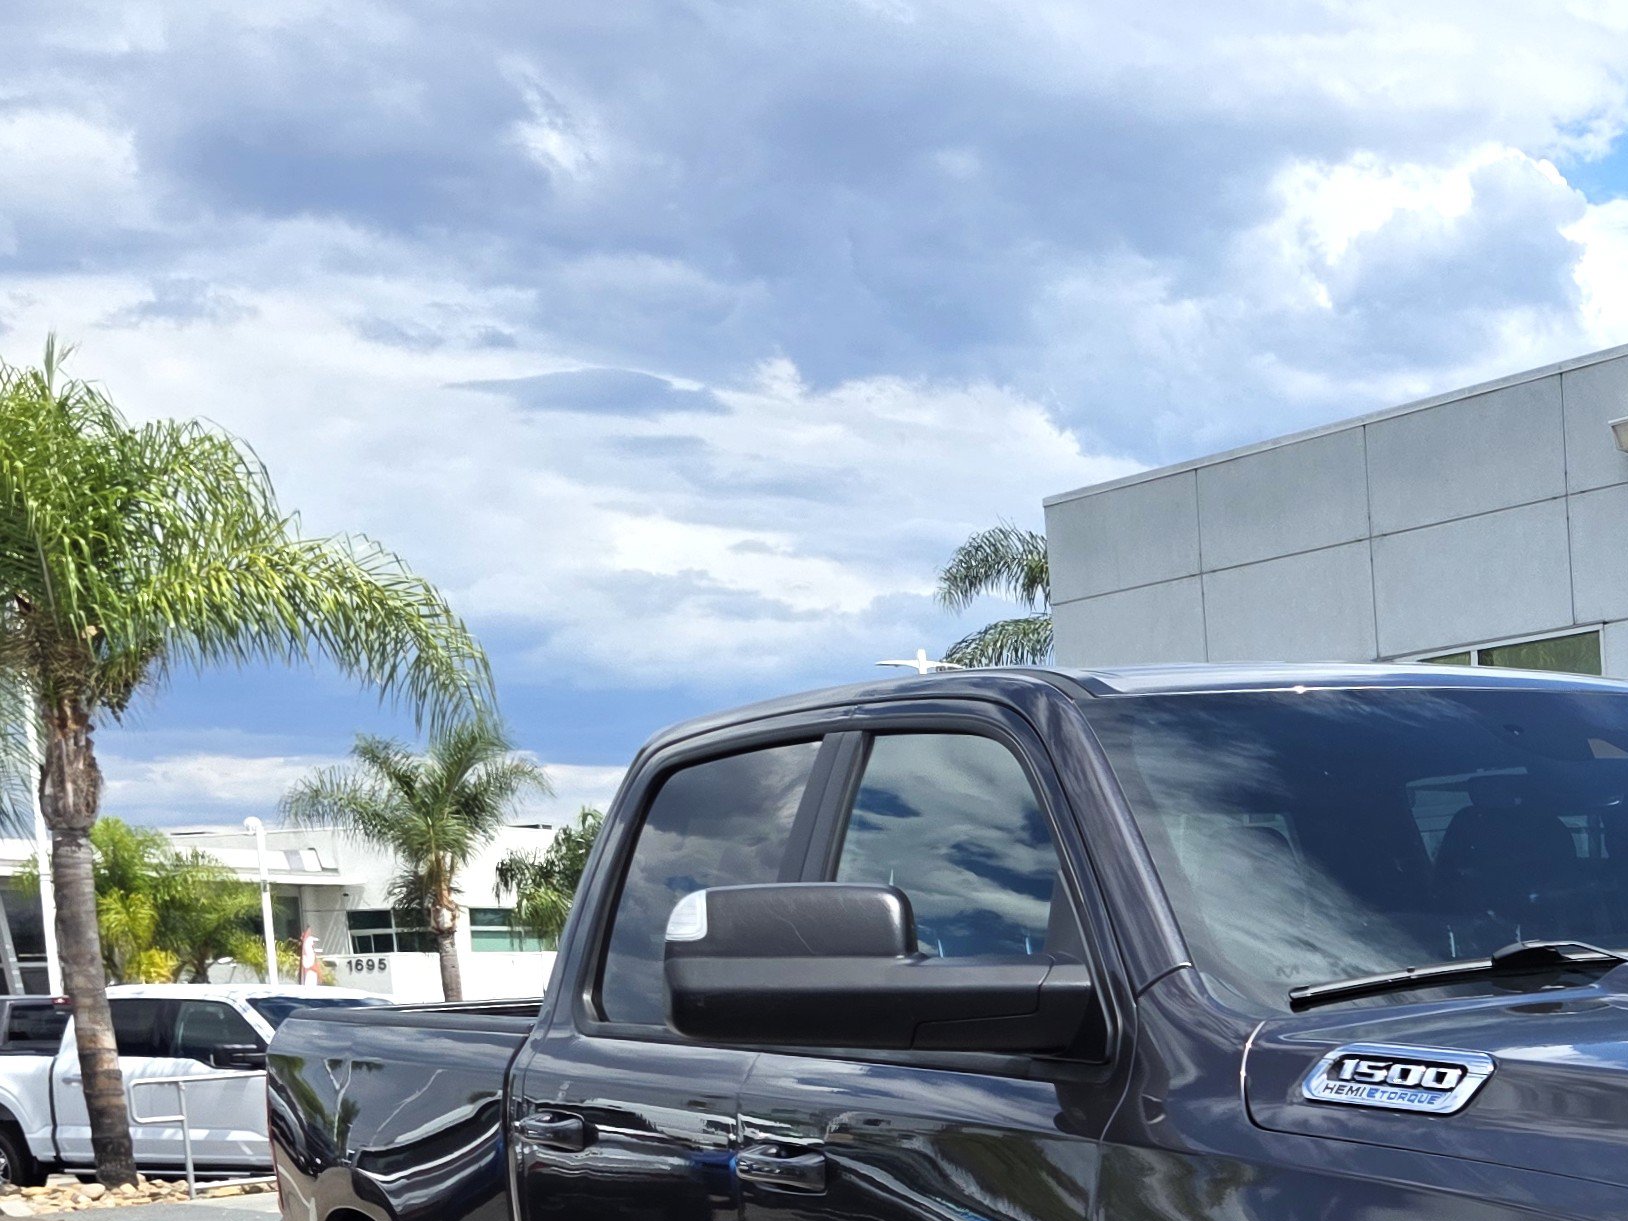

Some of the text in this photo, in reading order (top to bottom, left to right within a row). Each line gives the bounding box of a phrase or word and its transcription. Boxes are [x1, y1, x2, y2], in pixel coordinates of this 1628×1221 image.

[347, 958, 387, 973] 1695
[1336, 1058, 1463, 1091] 1500
[1322, 1082, 1364, 1098] HEMI
